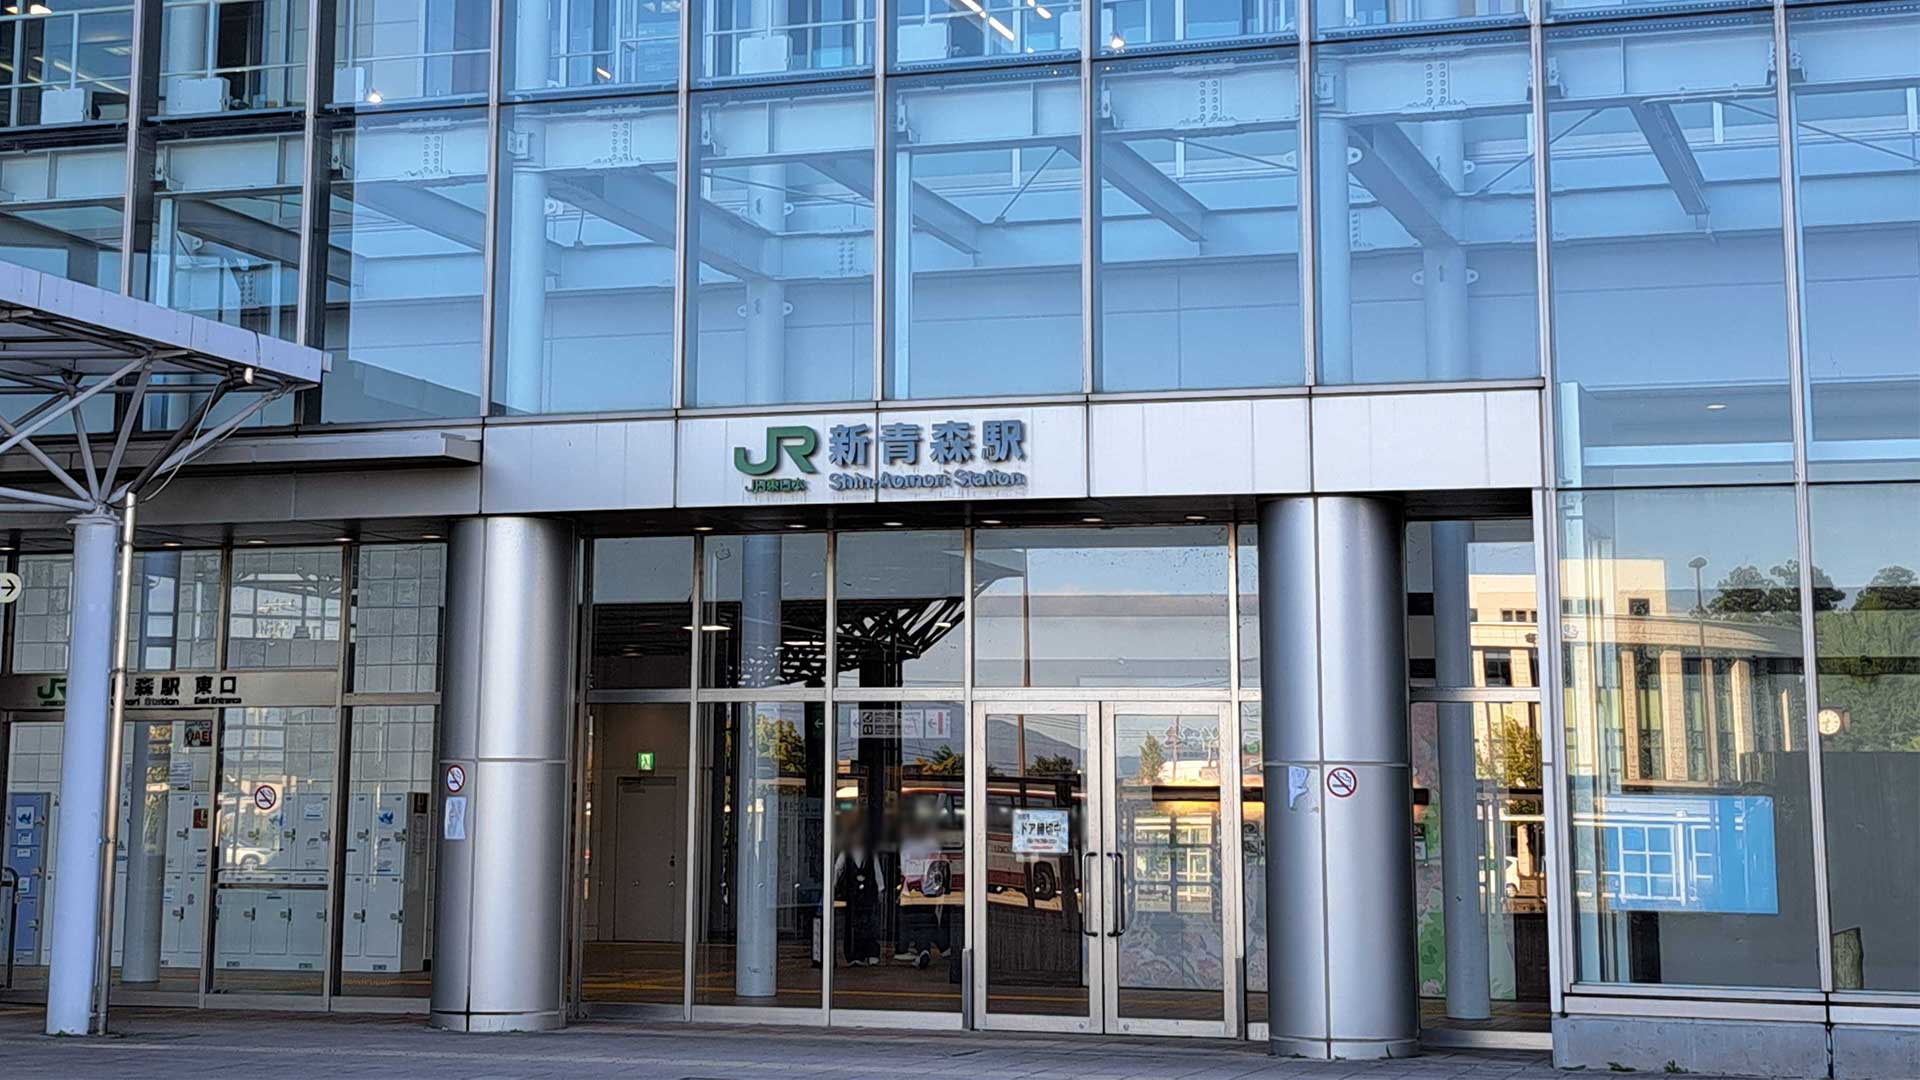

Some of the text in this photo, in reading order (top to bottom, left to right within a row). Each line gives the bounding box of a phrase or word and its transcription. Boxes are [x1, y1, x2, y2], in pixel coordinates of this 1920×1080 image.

[734, 426, 818, 476] JR
[829, 420, 1026, 465] 新青森駅
[829, 469, 1027, 491] Shin-Aomori Station
